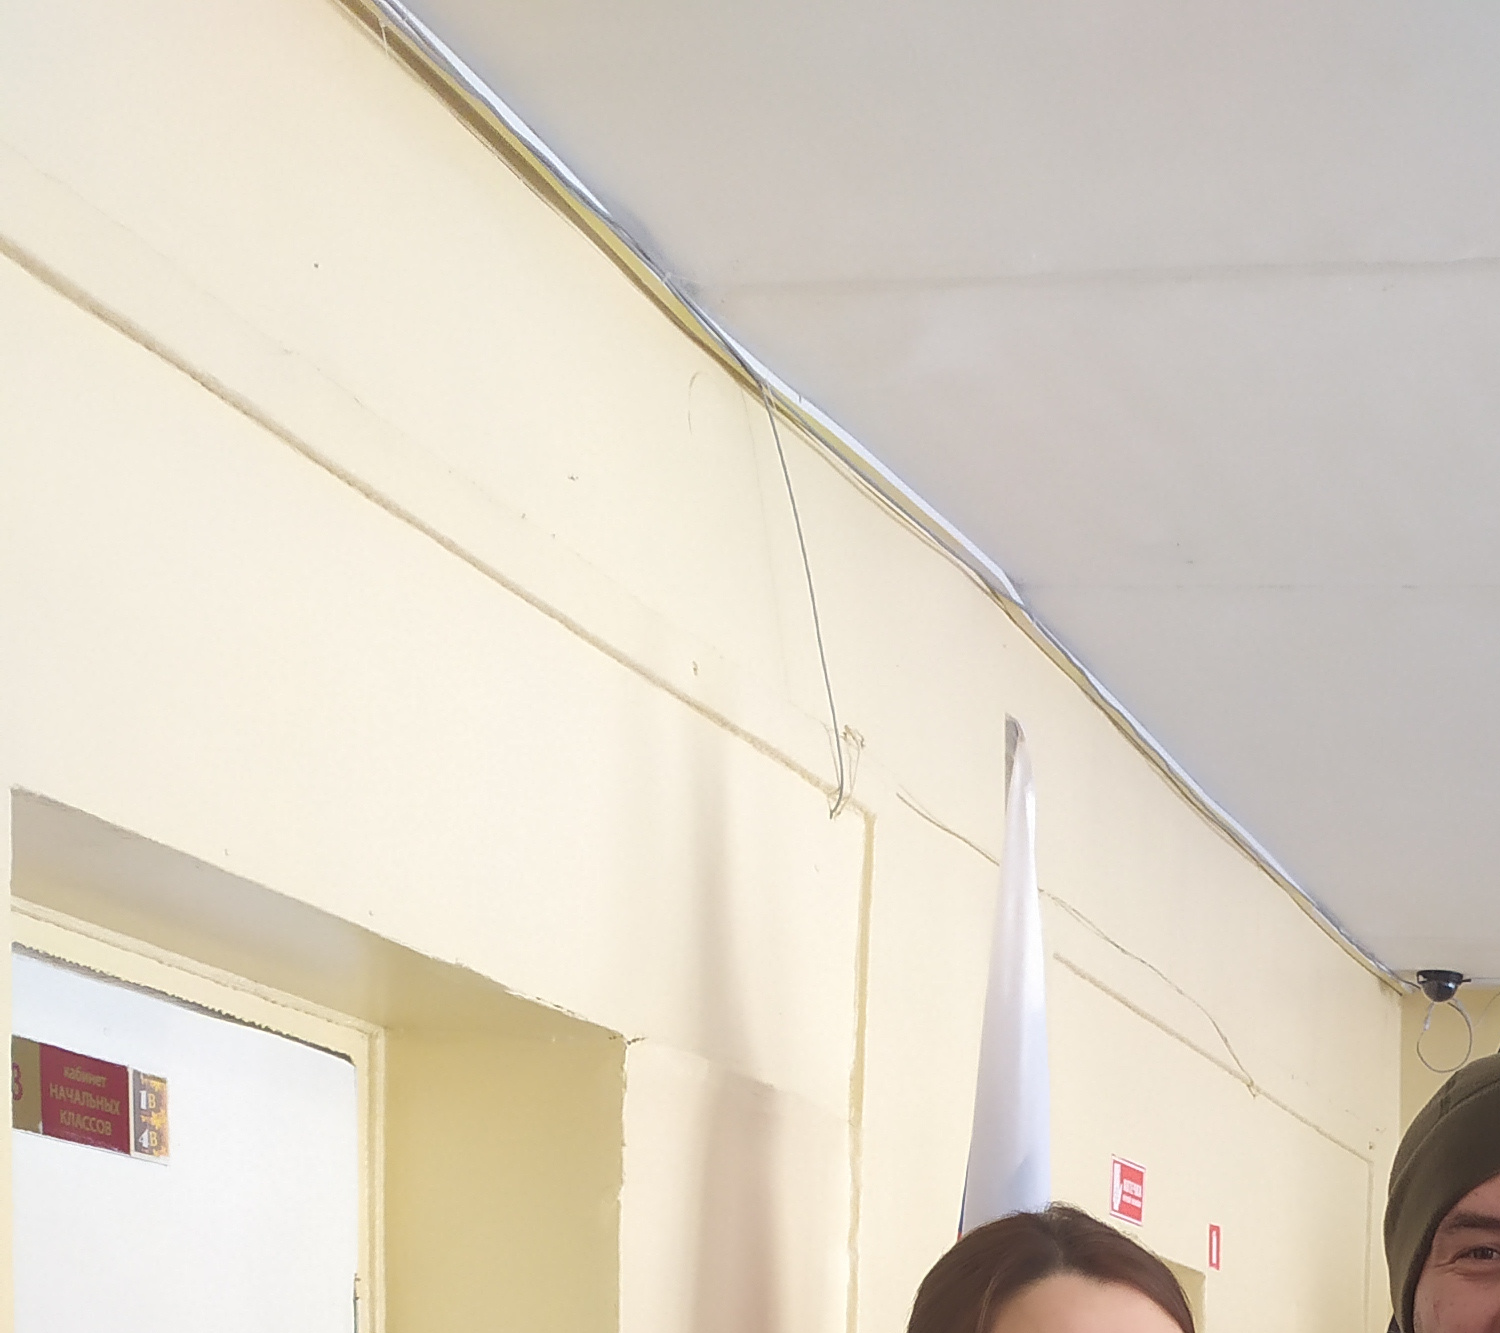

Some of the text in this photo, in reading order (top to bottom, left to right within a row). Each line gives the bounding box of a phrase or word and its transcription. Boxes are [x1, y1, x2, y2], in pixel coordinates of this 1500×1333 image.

[62, 1065, 108, 1088] кабинет
[49, 1083, 121, 1116] НАЧАЛЬНЫХ
[59, 1109, 113, 1137] КЛАССОВ
